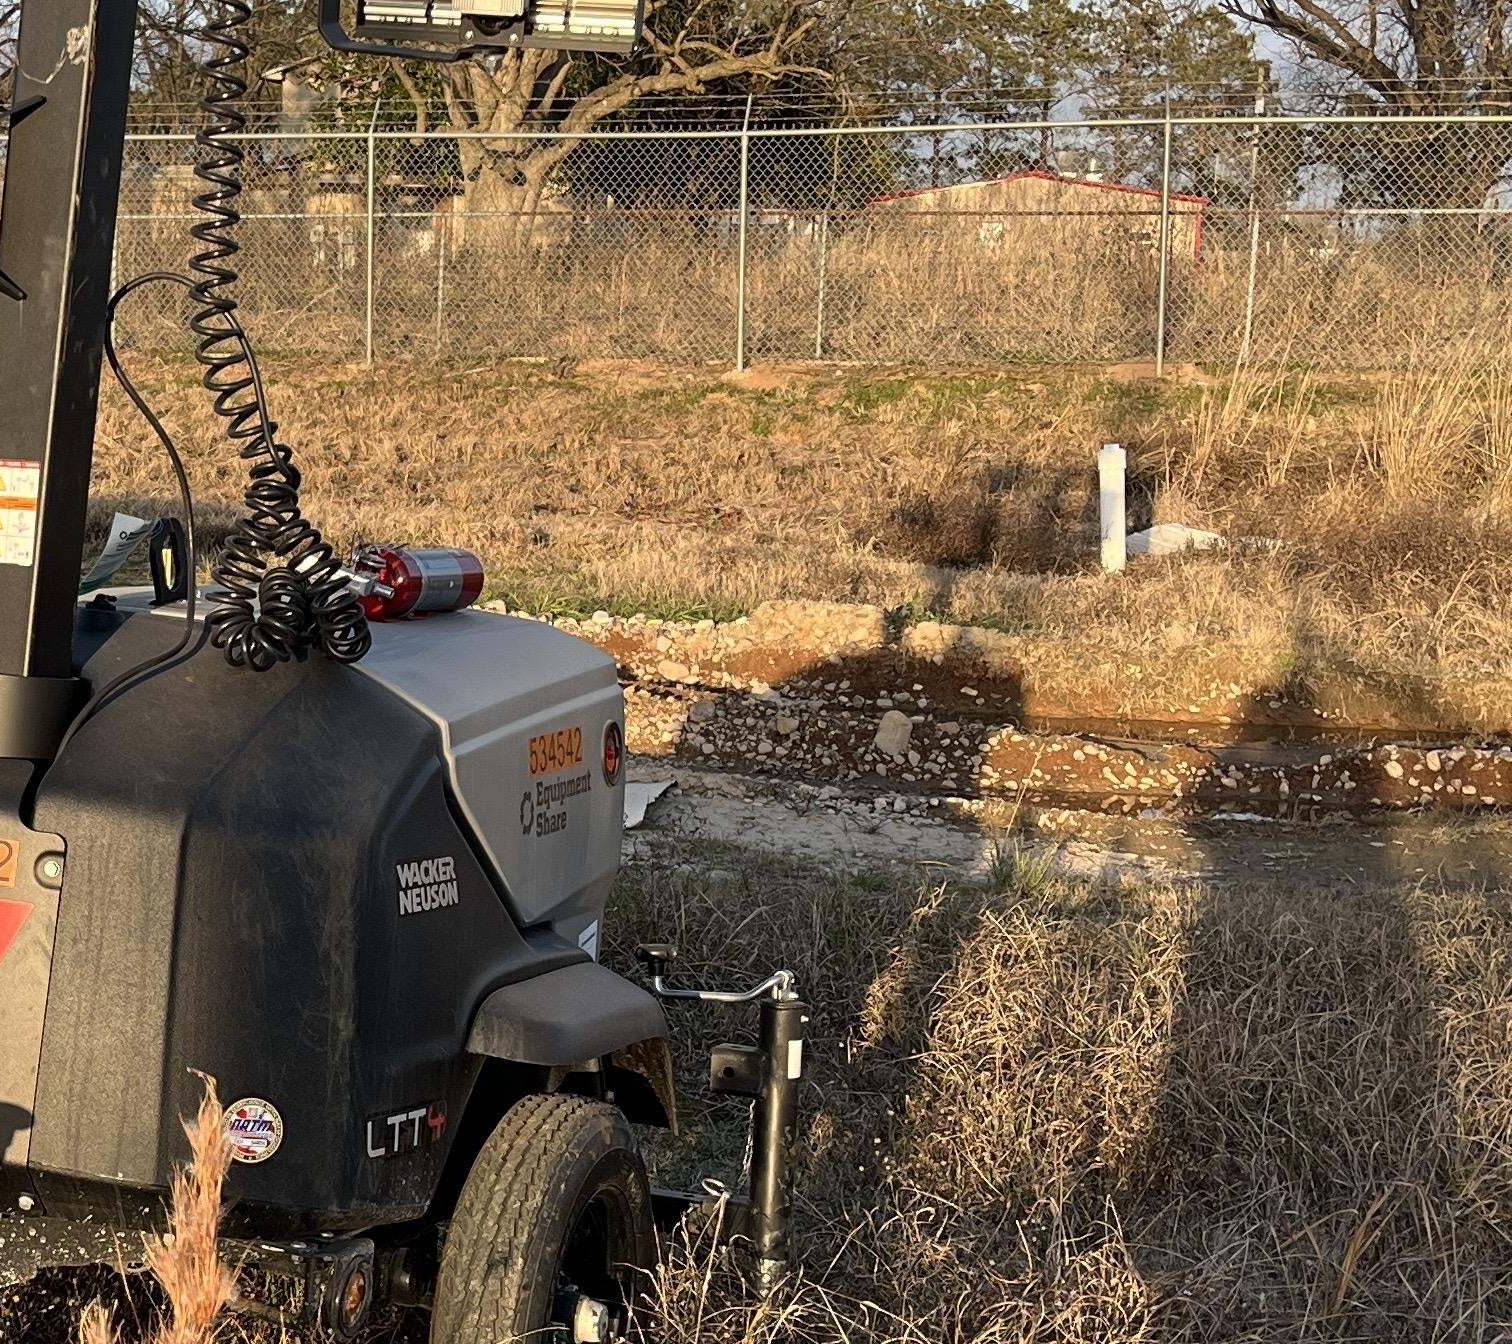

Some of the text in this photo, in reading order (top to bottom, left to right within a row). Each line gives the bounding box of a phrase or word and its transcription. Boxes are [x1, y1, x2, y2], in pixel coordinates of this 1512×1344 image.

[530, 727, 582, 775] 534542
[536, 770, 591, 809] Equipment
[536, 809, 567, 837] Share
[396, 856, 457, 888] WACKER
[399, 881, 459, 915] NEUSON
